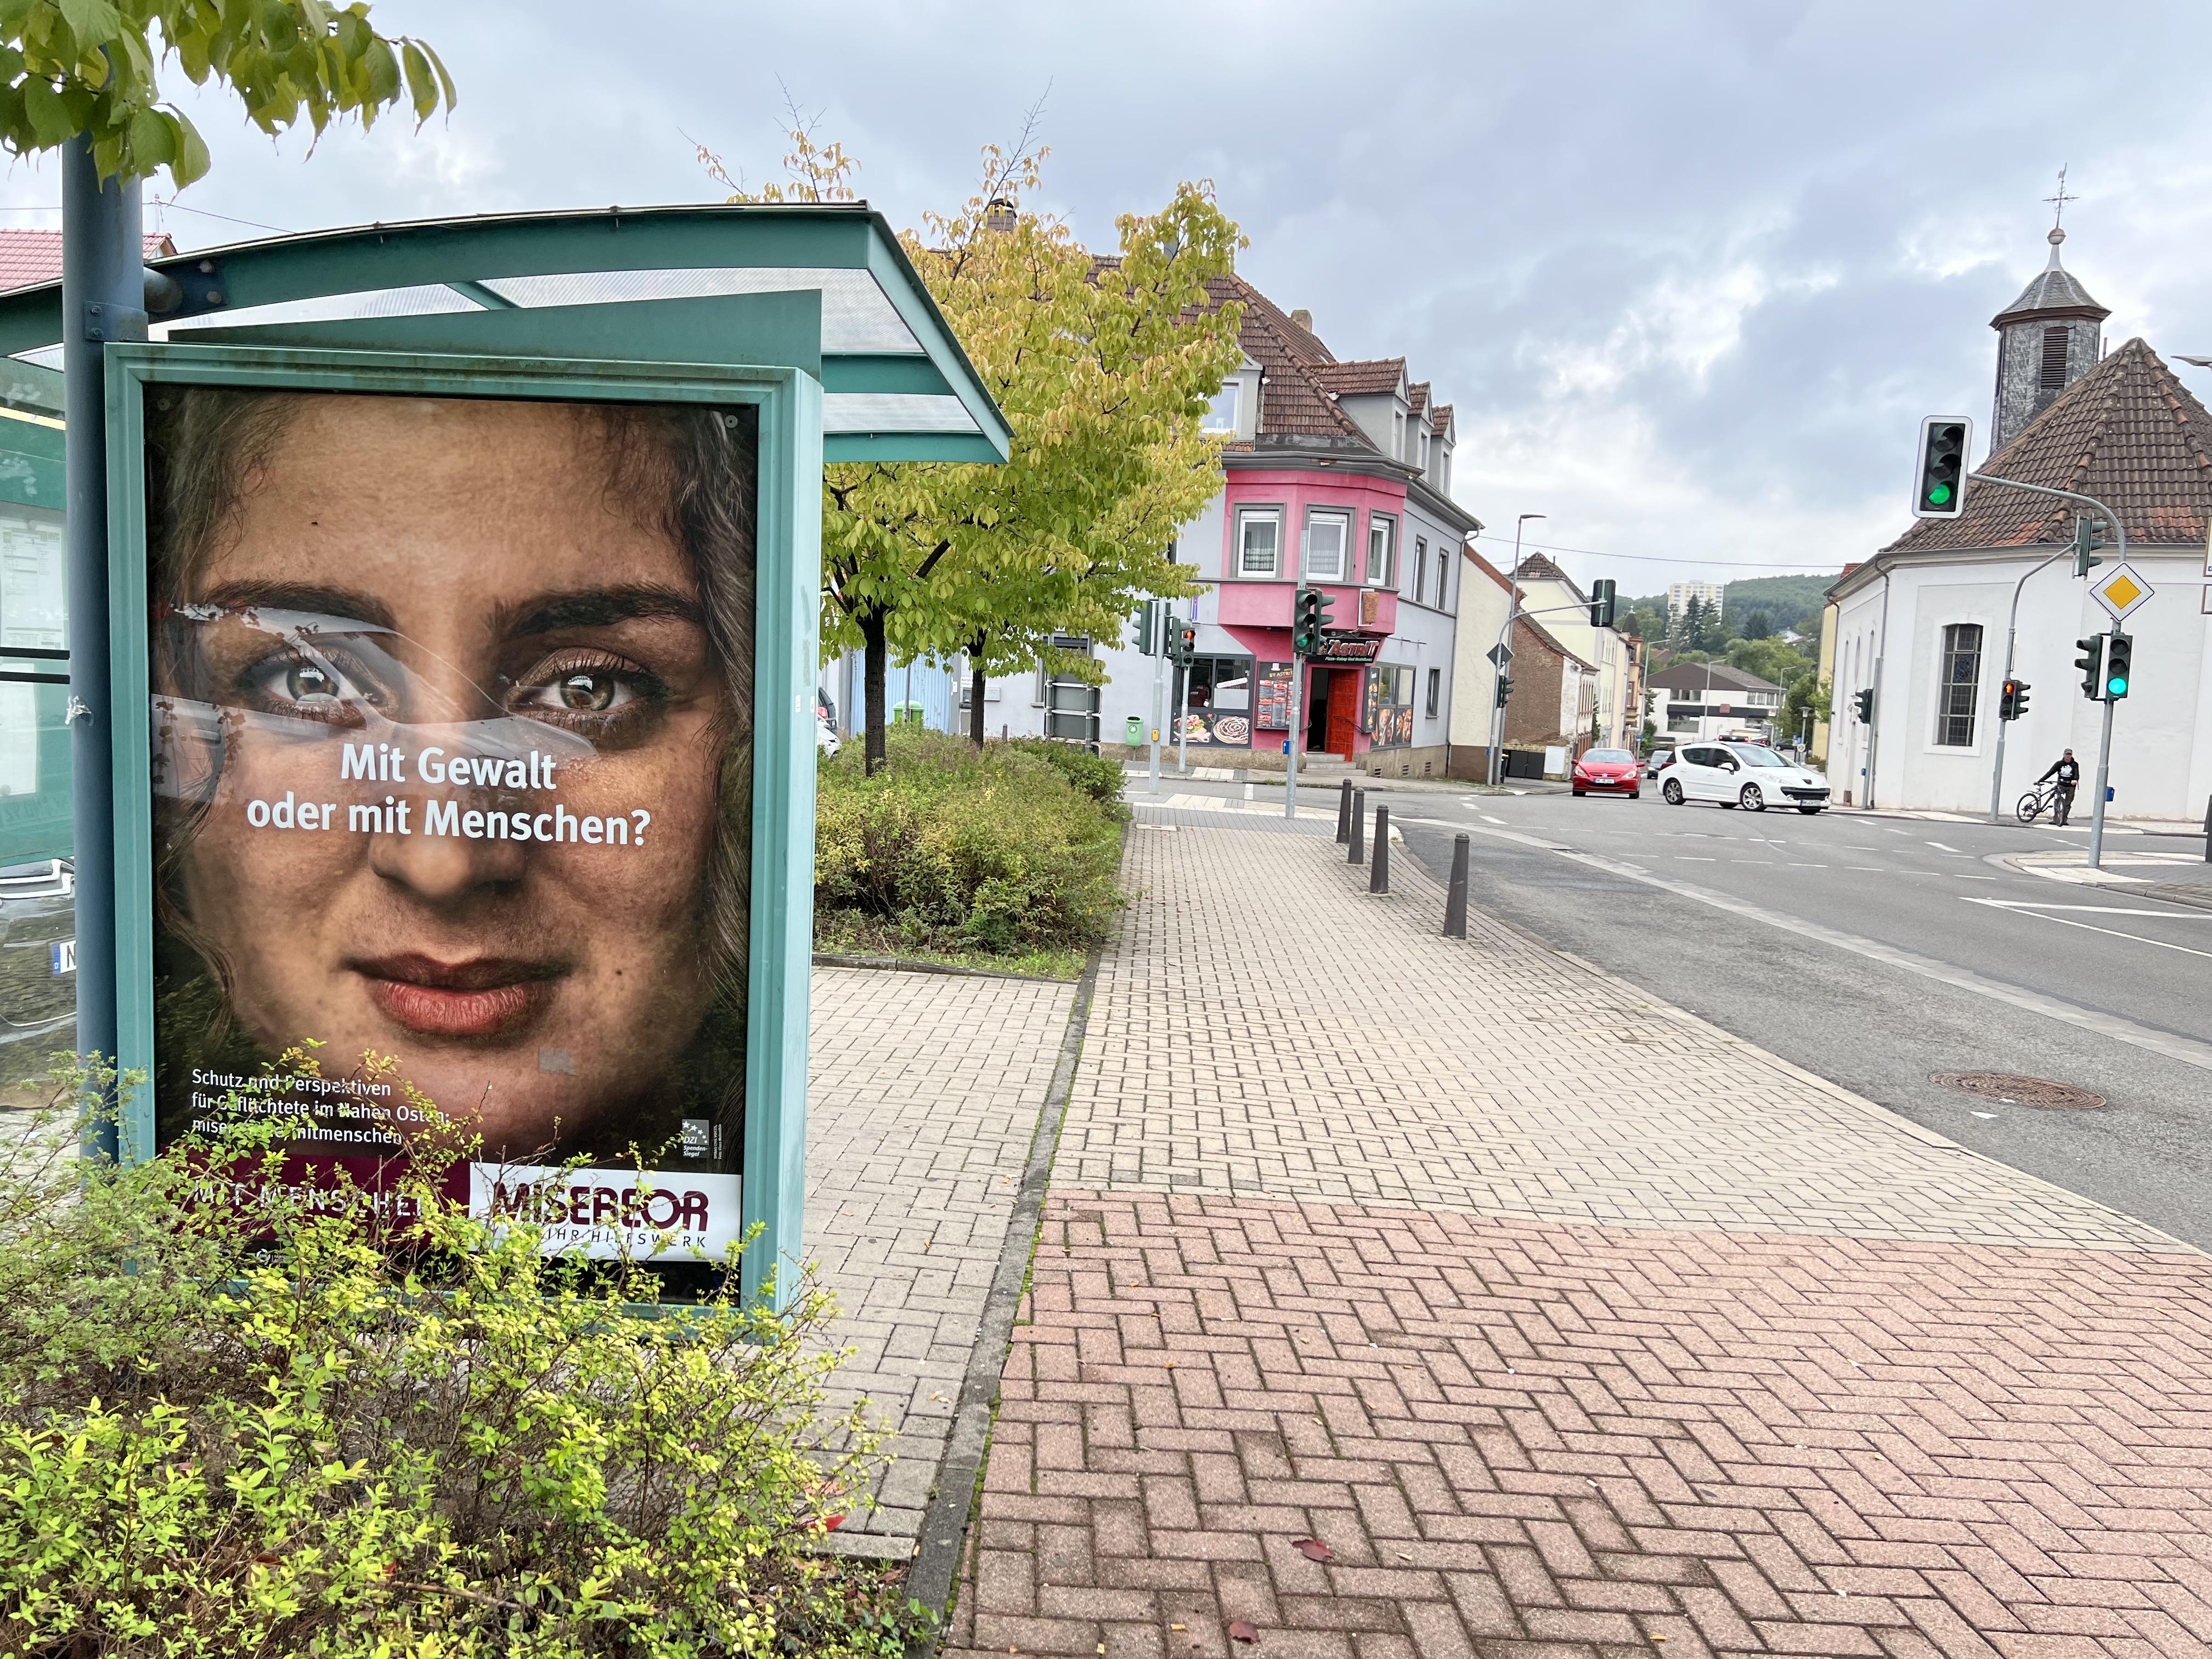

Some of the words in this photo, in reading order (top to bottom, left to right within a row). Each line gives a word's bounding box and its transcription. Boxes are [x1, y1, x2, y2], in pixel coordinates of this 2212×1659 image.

[341, 743, 405, 783] Mit
[418, 747, 556, 790] Gewalt
[247, 791, 336, 831] oder
[349, 796, 411, 836] mit
[424, 799, 651, 846] Menschen?
[192, 1068, 243, 1088] Schutz
[192, 1092, 212, 1109] für
[217, 1095, 309, 1115] Gflüchtete
[314, 1100, 333, 1117] im
[397, 1105, 449, 1124] Ostn:
[260, 1186, 421, 1216] MENSCHE
[494, 1181, 708, 1232] MISEREOR
[591, 1231, 706, 1248] HIFSWRK
